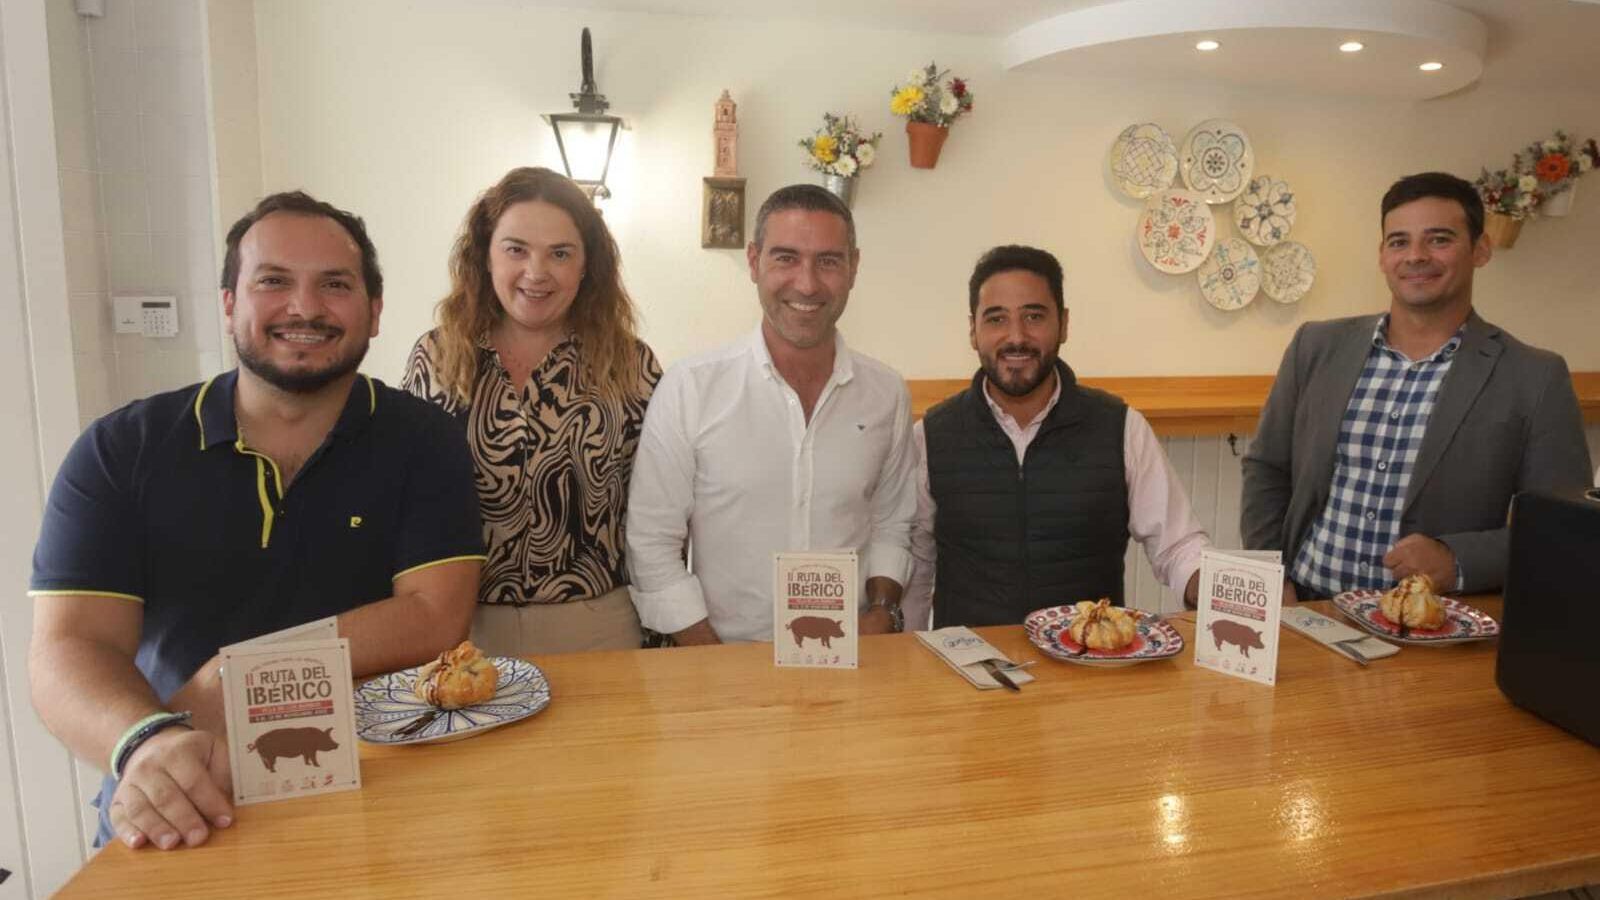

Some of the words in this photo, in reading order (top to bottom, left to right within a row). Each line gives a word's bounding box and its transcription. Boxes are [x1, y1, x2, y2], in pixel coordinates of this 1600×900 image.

[787, 572, 794, 582] II
[797, 572, 821, 582] RUTA
[824, 572, 844, 583] DEL
[1222, 573, 1245, 588] RUTA
[1248, 579, 1268, 593] DEL
[787, 582, 844, 597] IBÉRICO
[245, 672, 254, 686] II
[260, 668, 297, 684] RUTA
[302, 666, 331, 680] DEL
[245, 680, 332, 706] IBÉRICO
